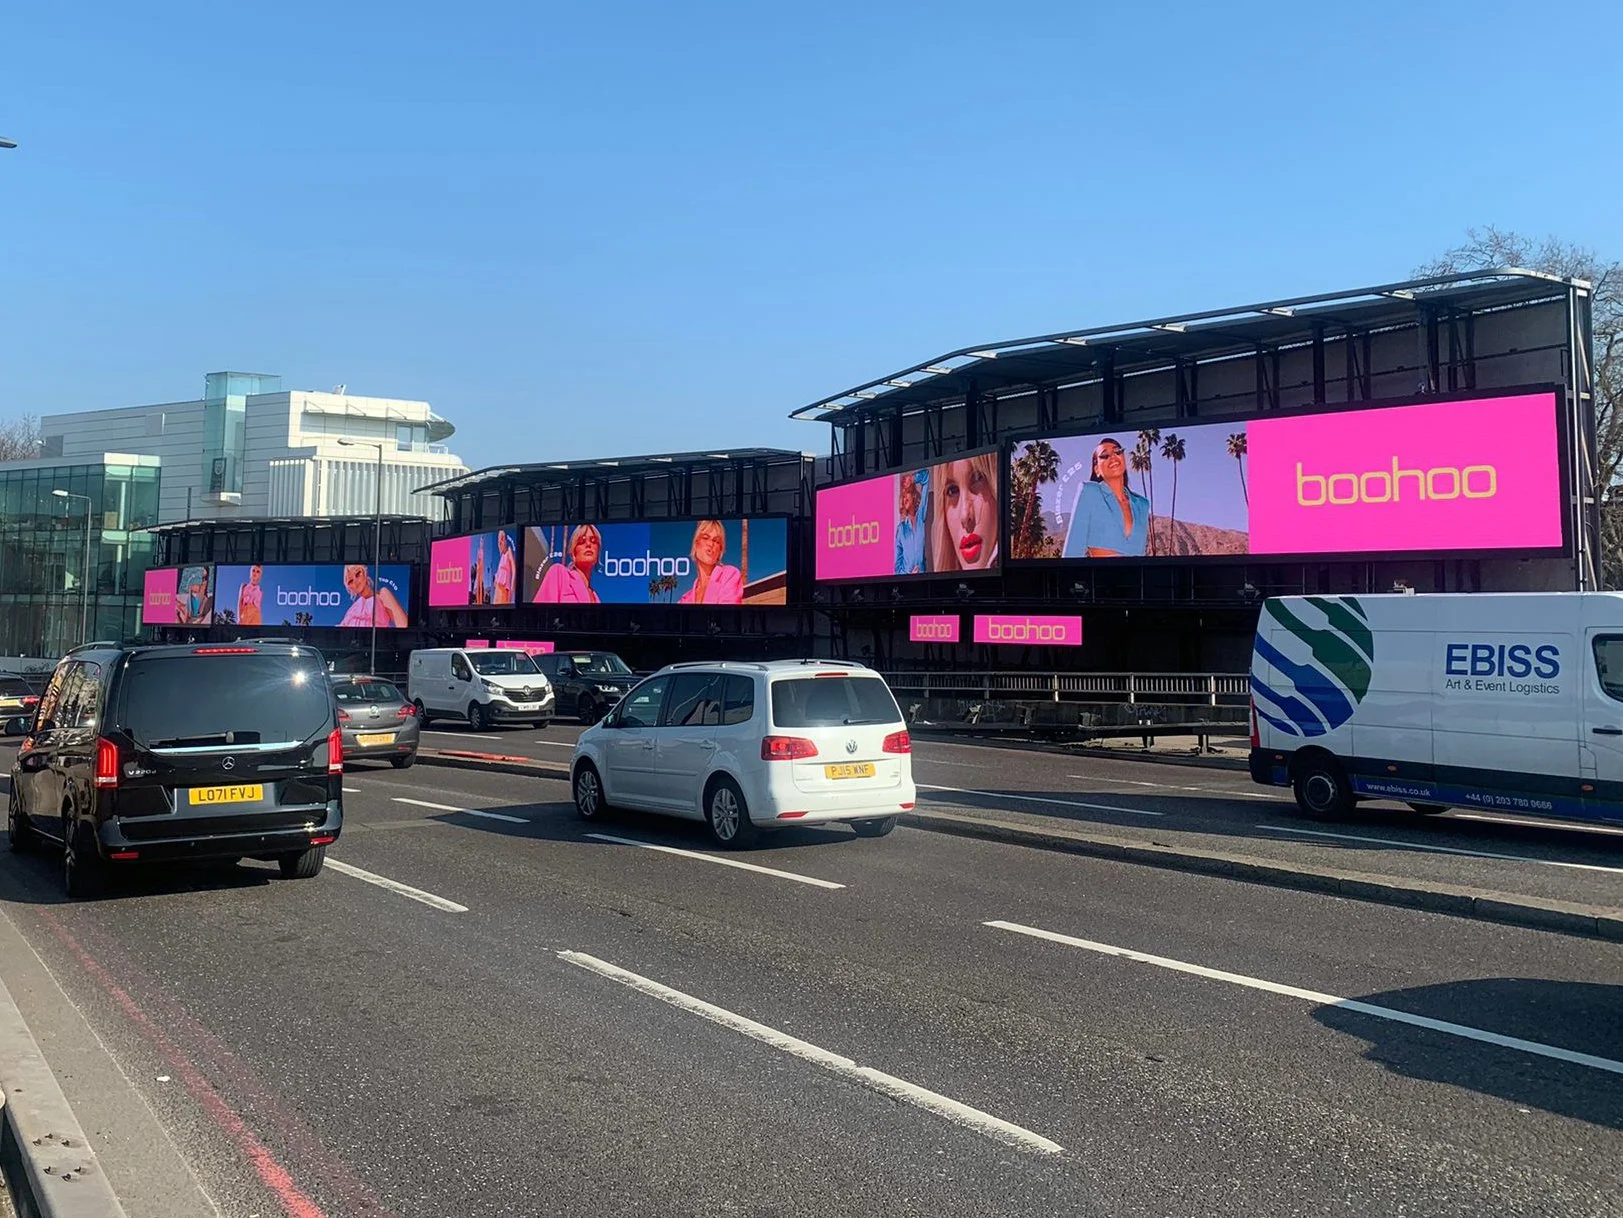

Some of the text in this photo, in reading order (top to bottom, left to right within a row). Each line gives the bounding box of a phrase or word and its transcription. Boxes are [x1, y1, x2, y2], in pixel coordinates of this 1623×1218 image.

[1296, 455, 1497, 506] boohoo
[828, 514, 880, 548] boohoo
[605, 549, 690, 577] boohoo
[276, 585, 341, 606] boohoo
[916, 617, 952, 638] boohoo
[988, 617, 1066, 641] boohoo
[1445, 643, 1561, 679] EBISS
[1445, 679, 1561, 696] Art & Event Logistics
[198, 787, 255, 802] LO71 FVJ
[1366, 783, 1431, 796] www.ebiss.co.uk
